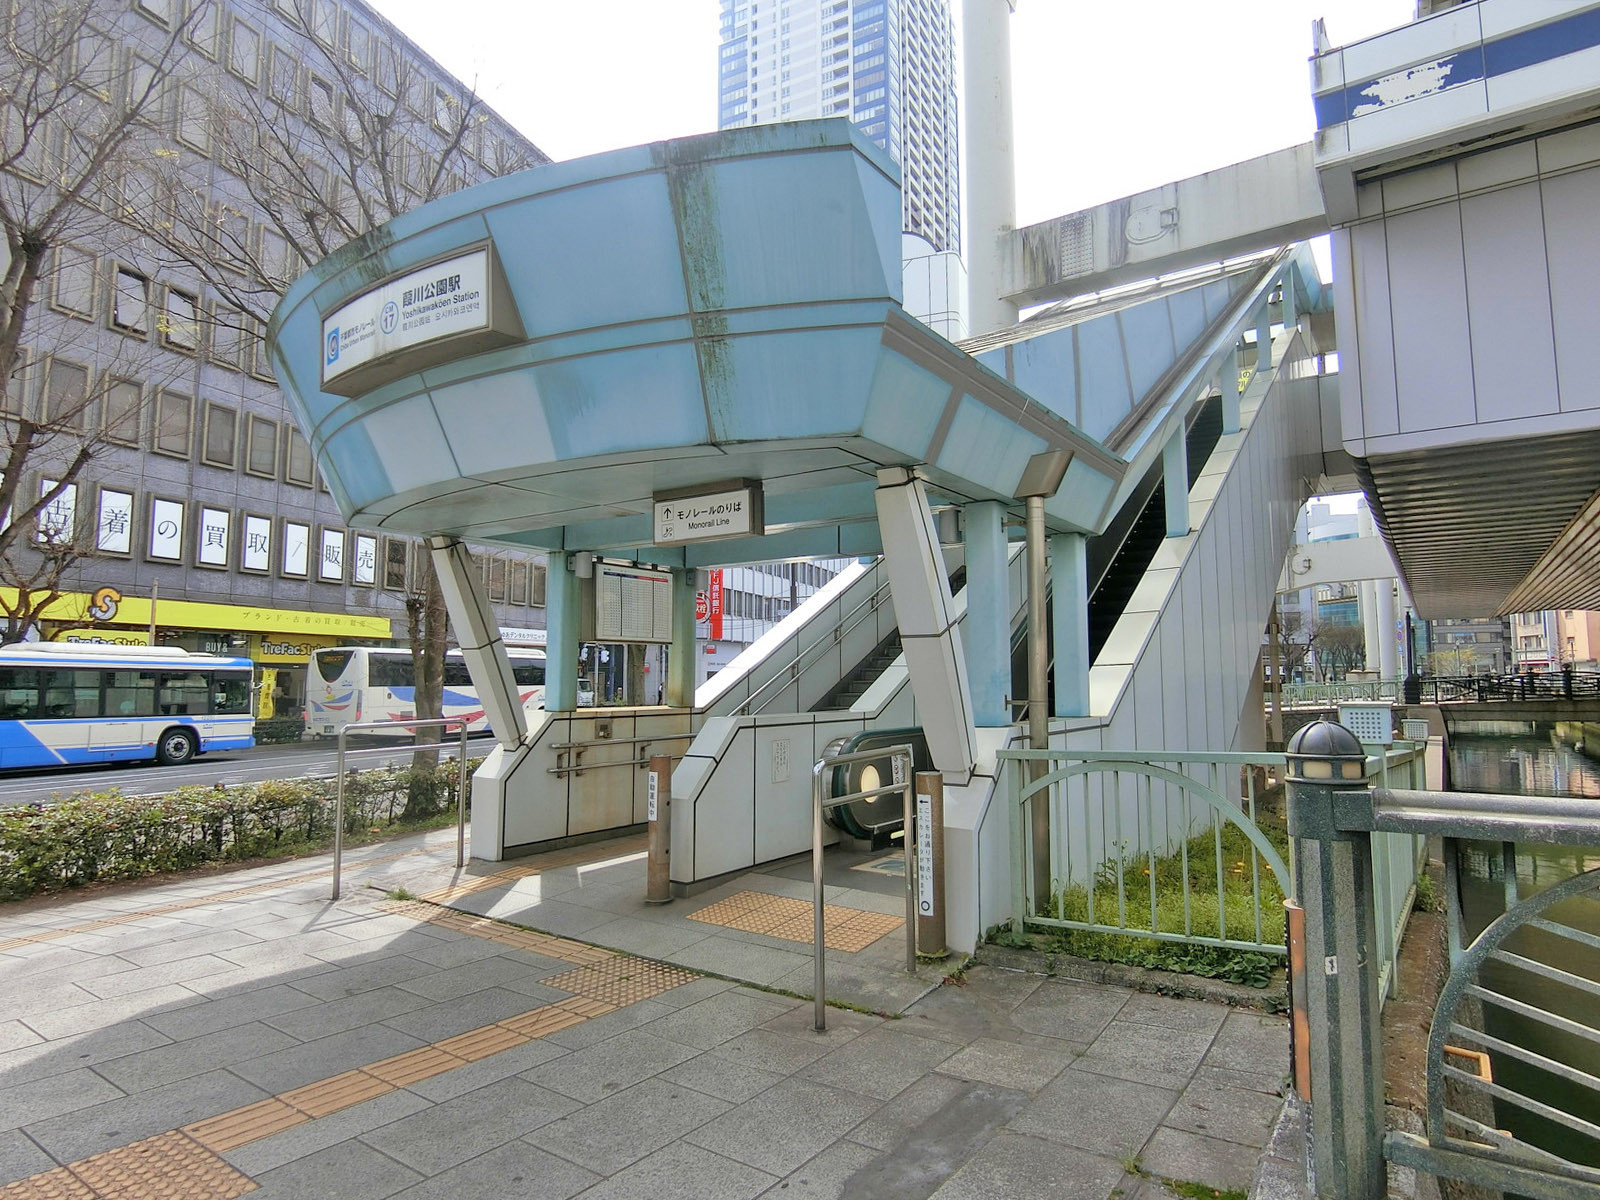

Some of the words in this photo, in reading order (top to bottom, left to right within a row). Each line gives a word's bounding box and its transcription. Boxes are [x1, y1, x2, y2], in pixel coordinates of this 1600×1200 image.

[452, 290, 480, 305] Station
[384, 313, 395, 329] 17
[677, 501, 742, 520] モノレールのりば
[688, 518, 715, 530] Monorail
[716, 518, 730, 527] Line
